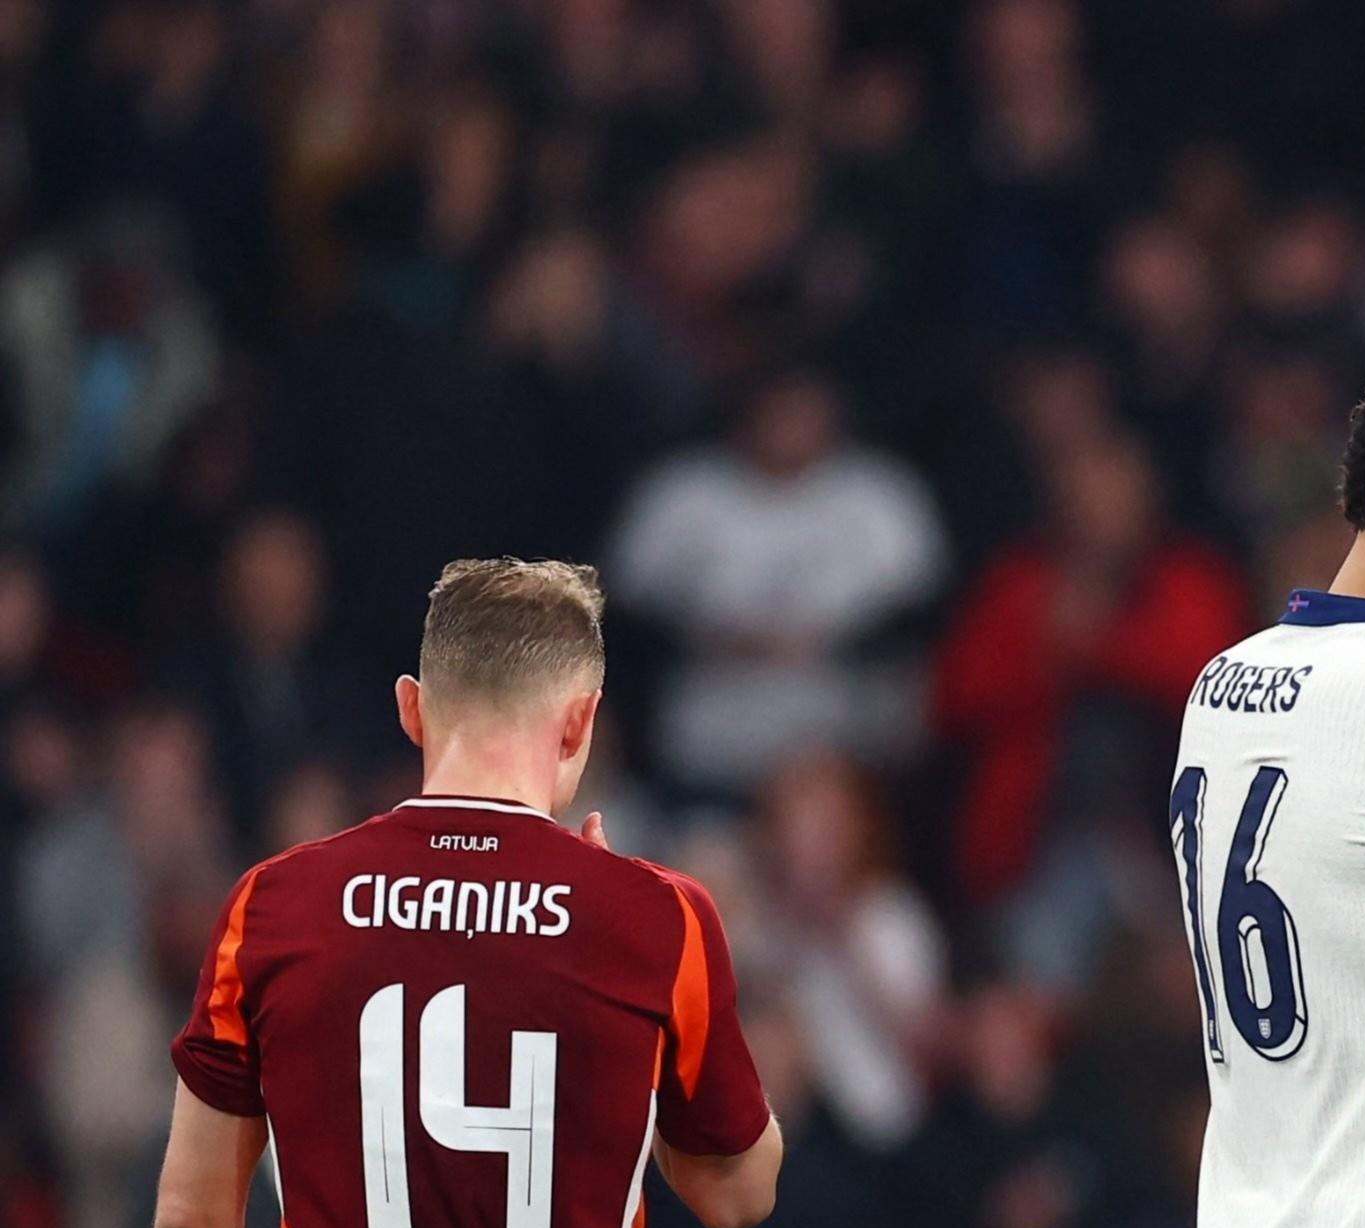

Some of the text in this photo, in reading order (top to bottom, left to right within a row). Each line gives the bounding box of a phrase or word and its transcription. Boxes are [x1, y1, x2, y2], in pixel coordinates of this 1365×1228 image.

[1190, 656, 1313, 713] ROGERS
[342, 874, 572, 939] CIGAŅIKS
[1170, 766, 1309, 1062] 16
